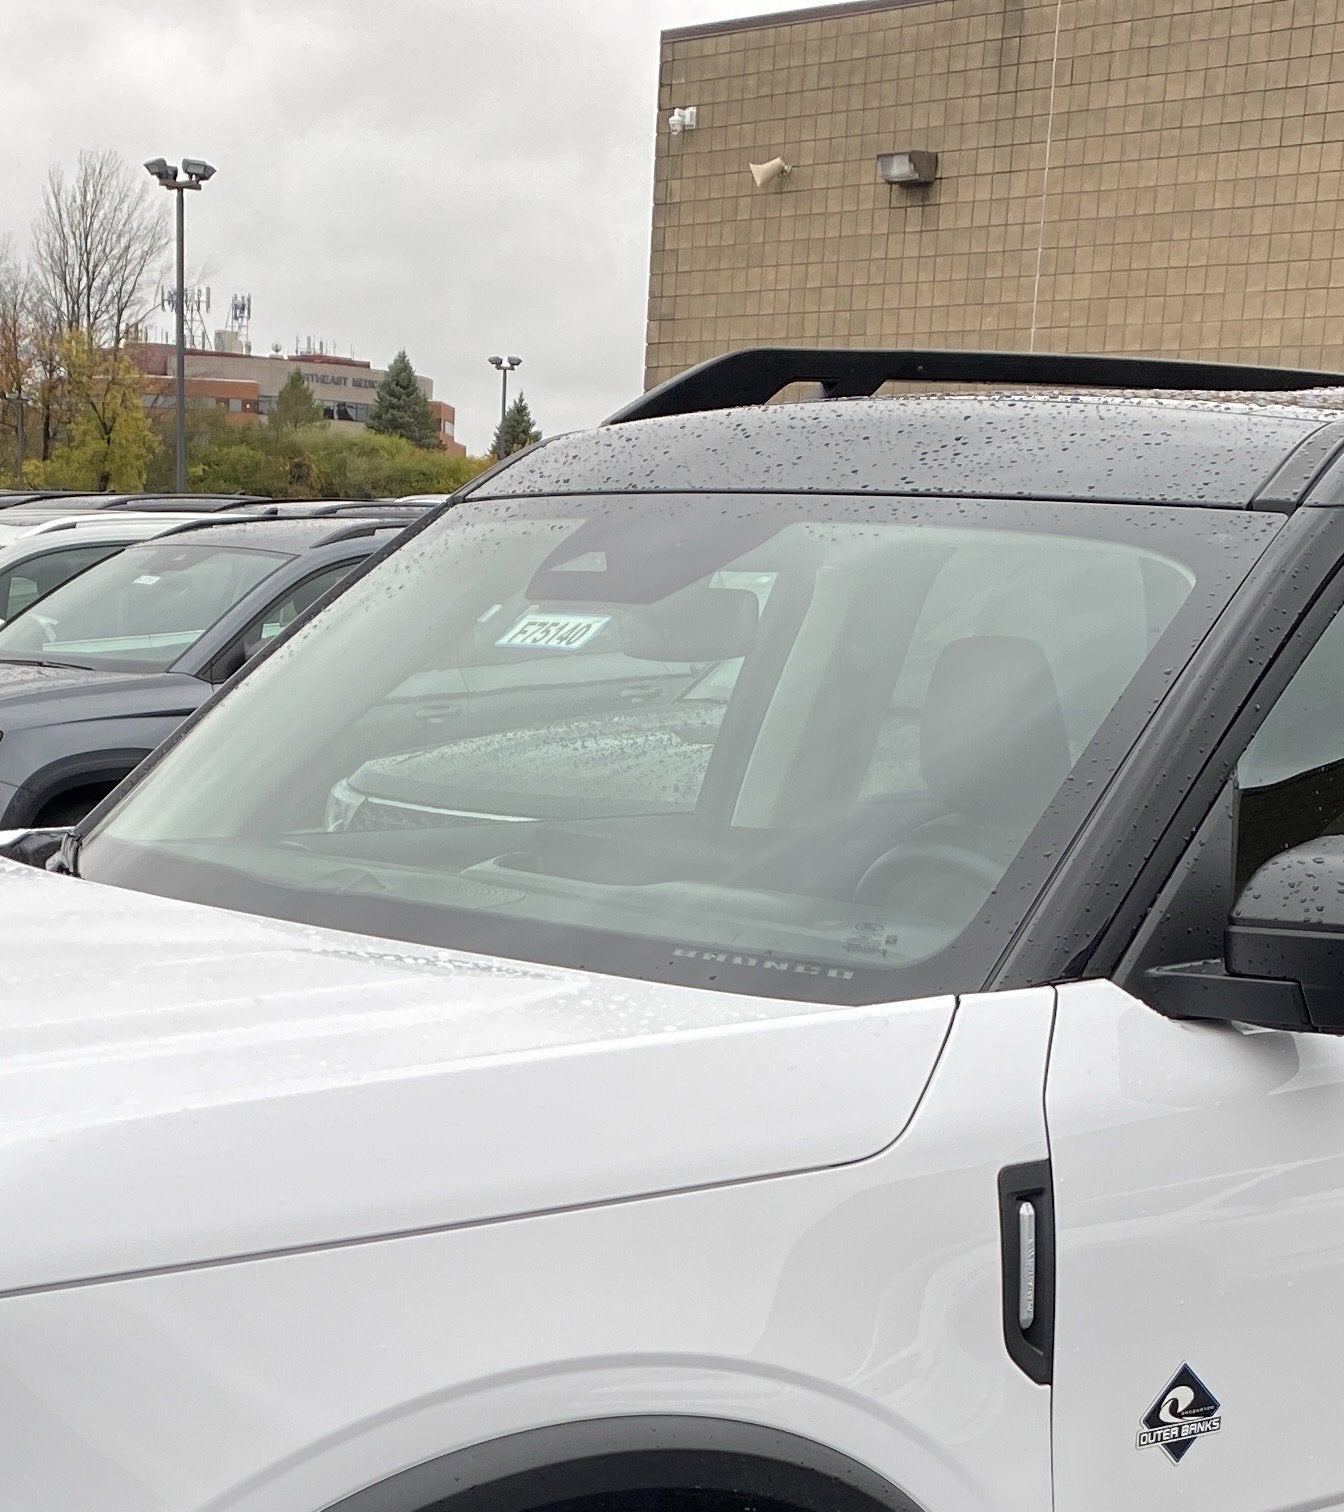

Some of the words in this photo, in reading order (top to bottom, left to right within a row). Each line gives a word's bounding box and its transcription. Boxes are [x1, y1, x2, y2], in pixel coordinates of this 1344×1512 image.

[506, 620, 593, 646] F75140
[672, 948, 854, 980] BRONCO
[1139, 1426, 1179, 1446] OUTER
[1181, 1417, 1220, 1437] BANKS
